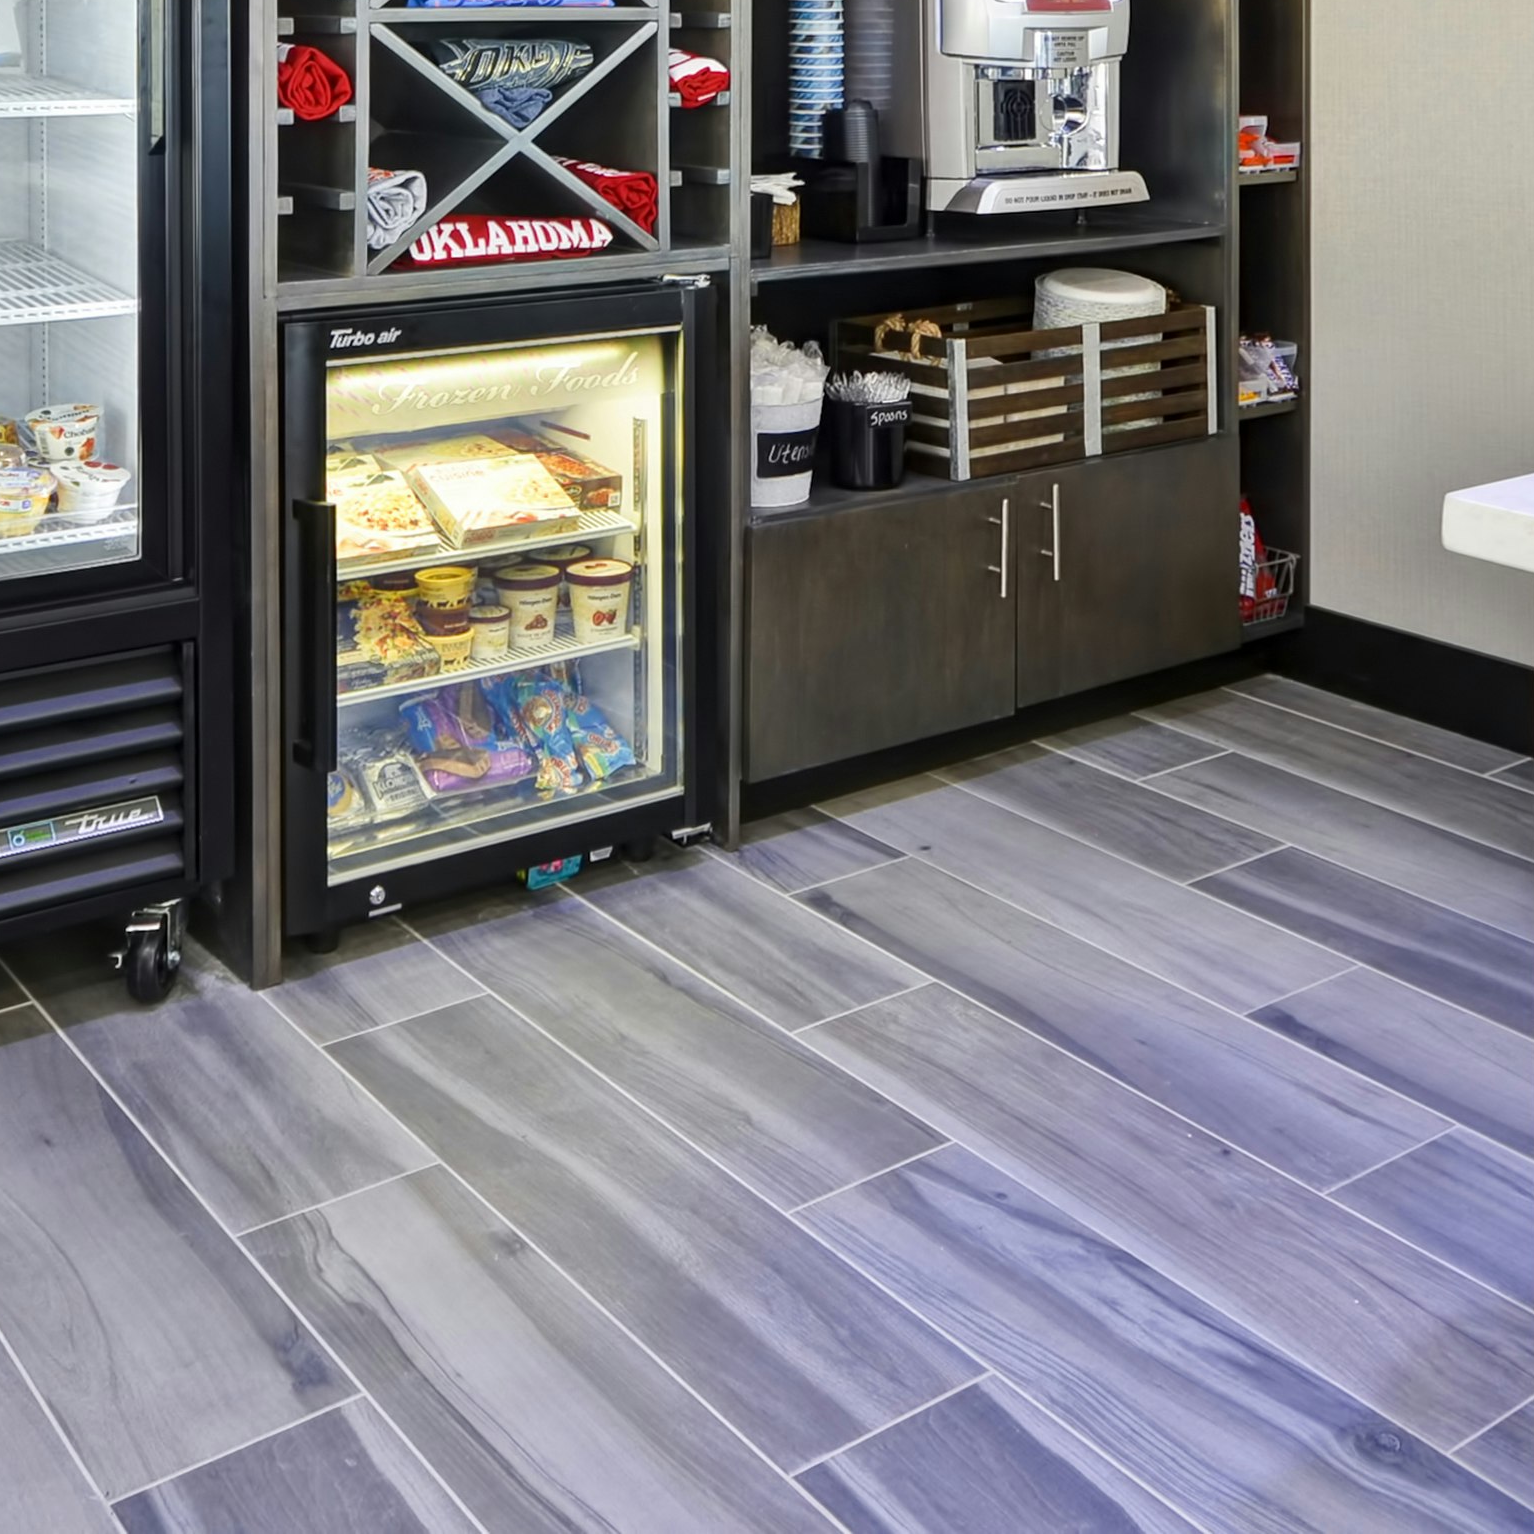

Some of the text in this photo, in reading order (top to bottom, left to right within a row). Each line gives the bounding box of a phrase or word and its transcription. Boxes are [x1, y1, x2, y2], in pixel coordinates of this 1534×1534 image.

[408, 217, 614, 262] OKLAHOMA
[329, 326, 402, 349] Turbo air
[371, 351, 640, 416] Frozen Foods
[870, 407, 909, 427] Spoons
